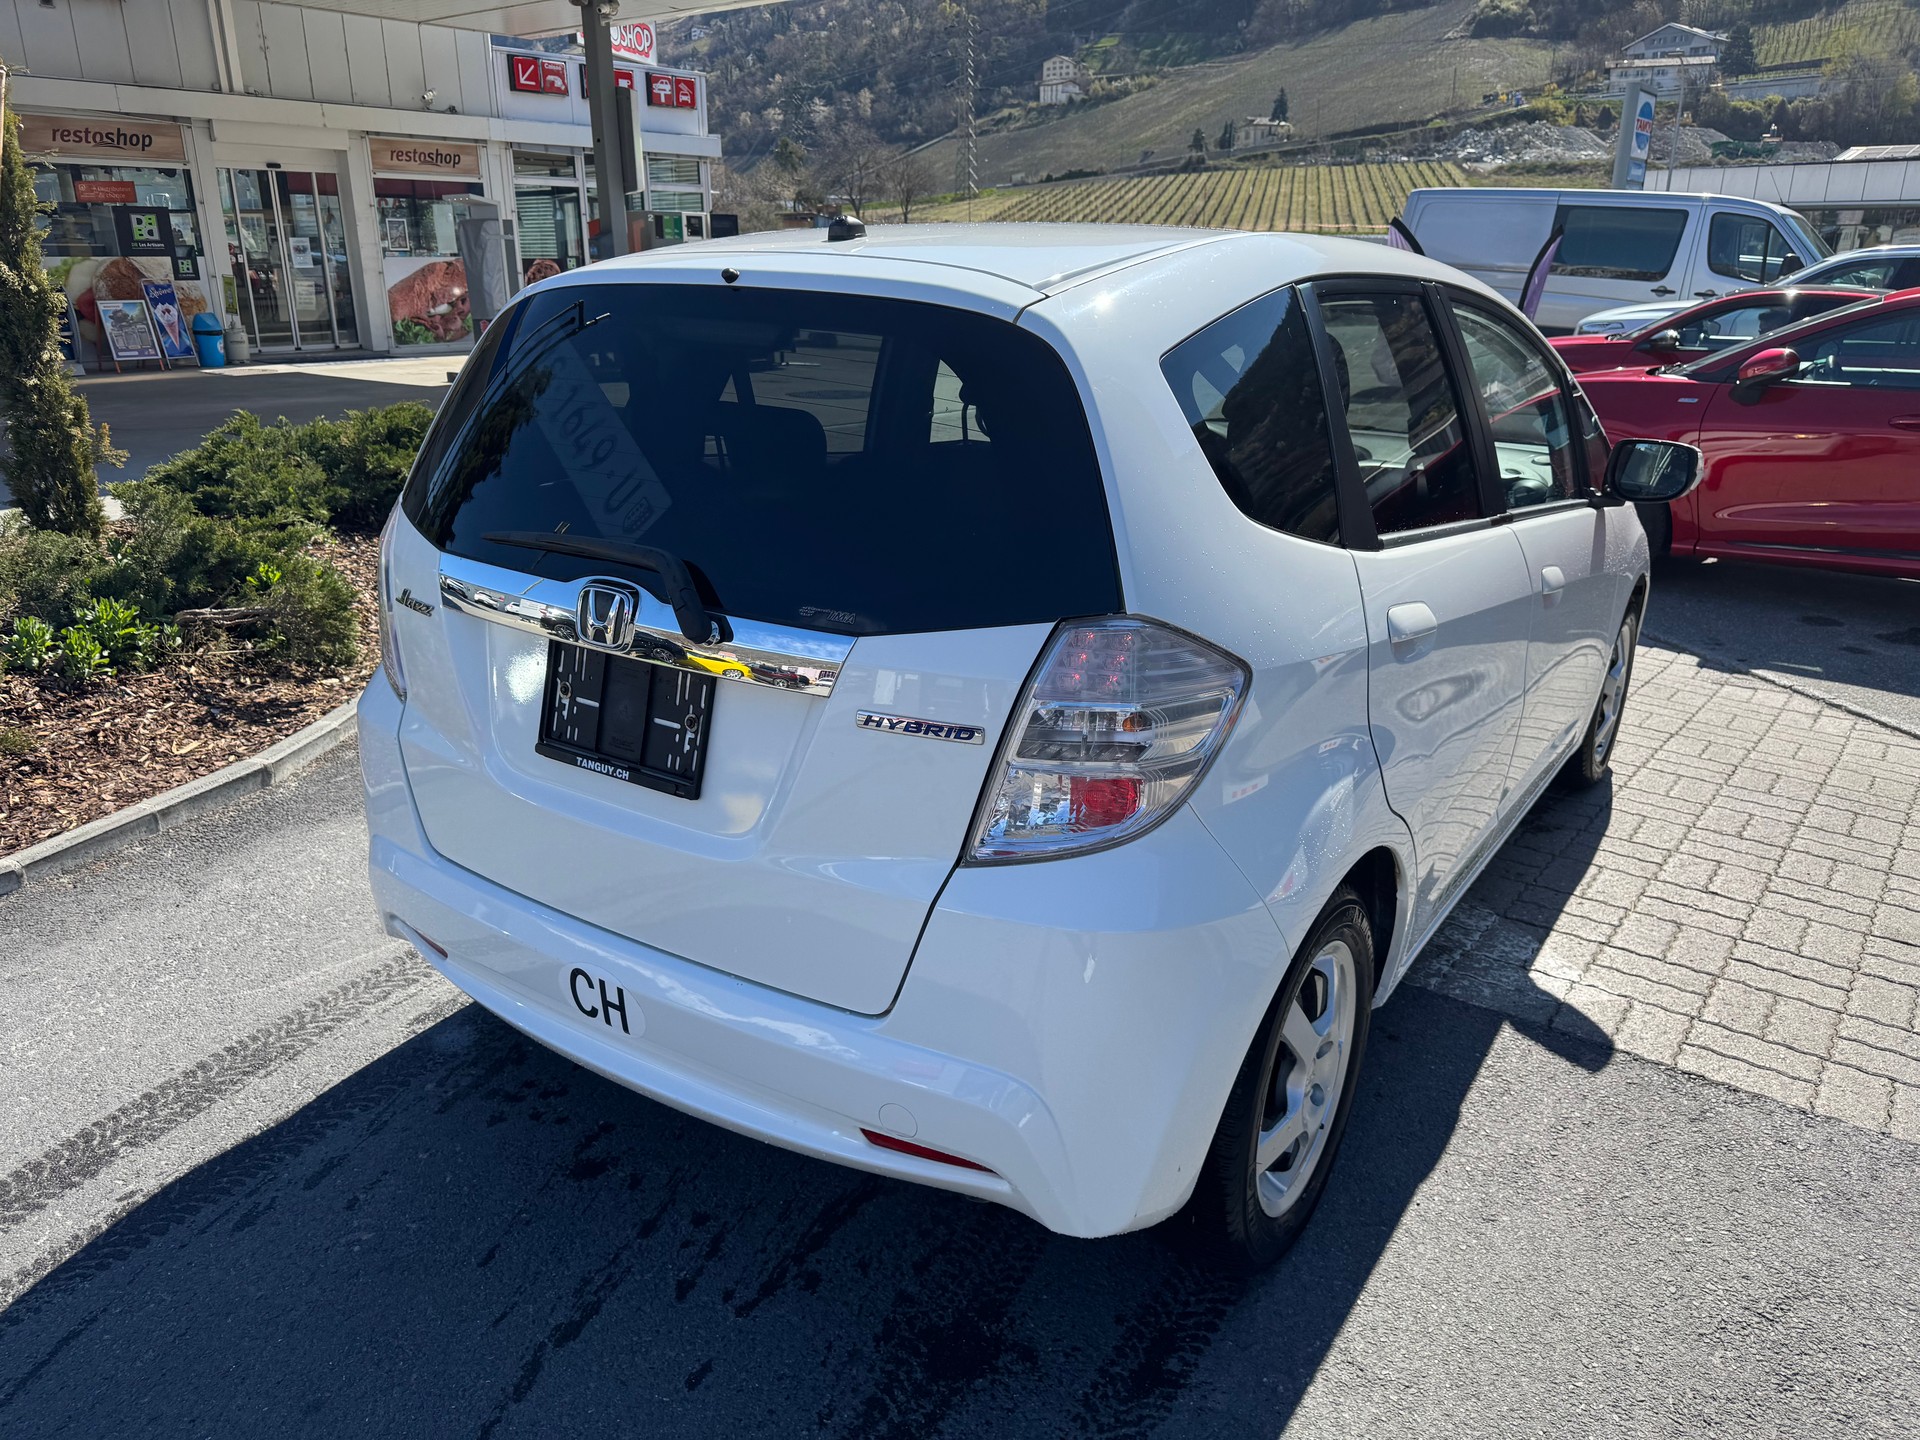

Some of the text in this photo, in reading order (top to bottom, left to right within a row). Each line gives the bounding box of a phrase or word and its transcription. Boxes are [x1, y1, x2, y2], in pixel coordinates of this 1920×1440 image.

[51, 127, 153, 151] restoshop
[390, 148, 462, 168] restoshop
[647, 213, 655, 222] 2
[395, 588, 435, 618] Jazz
[863, 714, 977, 741] HYBRID
[576, 756, 630, 781] TANGUY.CH
[569, 967, 631, 1036] CH
